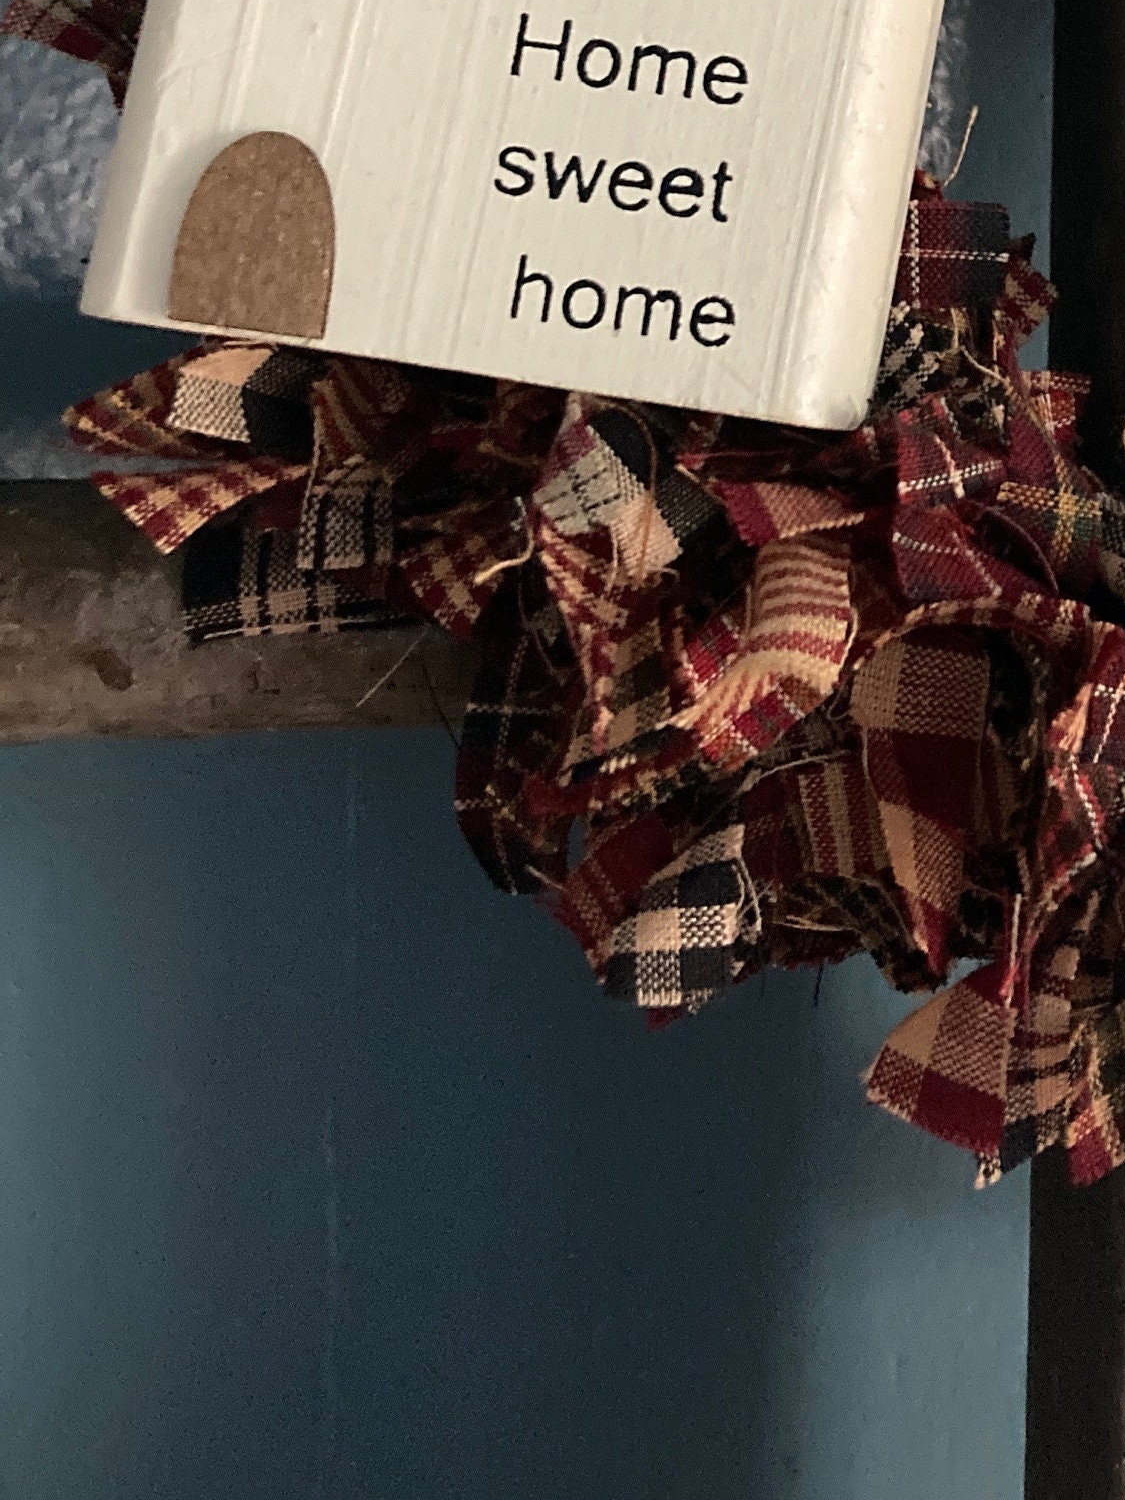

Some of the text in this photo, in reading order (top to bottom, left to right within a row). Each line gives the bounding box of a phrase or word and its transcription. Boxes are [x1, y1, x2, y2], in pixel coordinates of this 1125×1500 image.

[509, 12, 749, 106] Home
[493, 145, 734, 224] sweet
[509, 253, 736, 349] home
